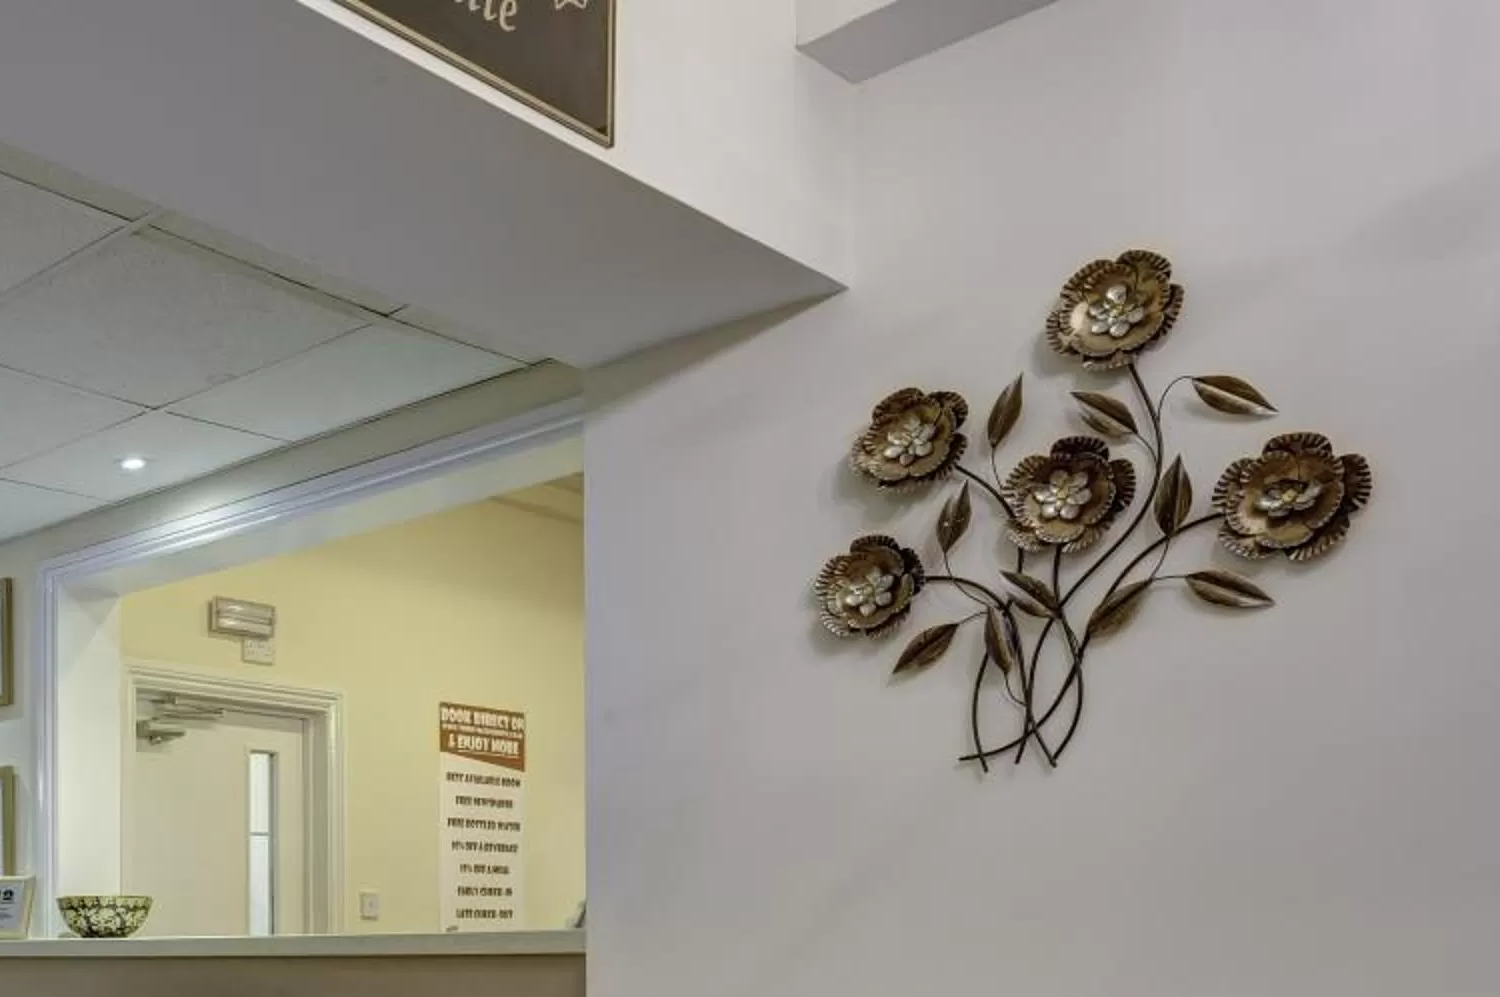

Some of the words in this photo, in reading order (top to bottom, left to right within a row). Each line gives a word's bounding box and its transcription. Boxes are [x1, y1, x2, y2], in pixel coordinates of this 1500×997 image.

[441, 706, 472, 724] BOOK
[473, 710, 509, 729] DIRECT
[457, 734, 489, 752] ENJOY
[490, 738, 520, 755] MORE
[465, 818, 496, 830] BOTTLED
